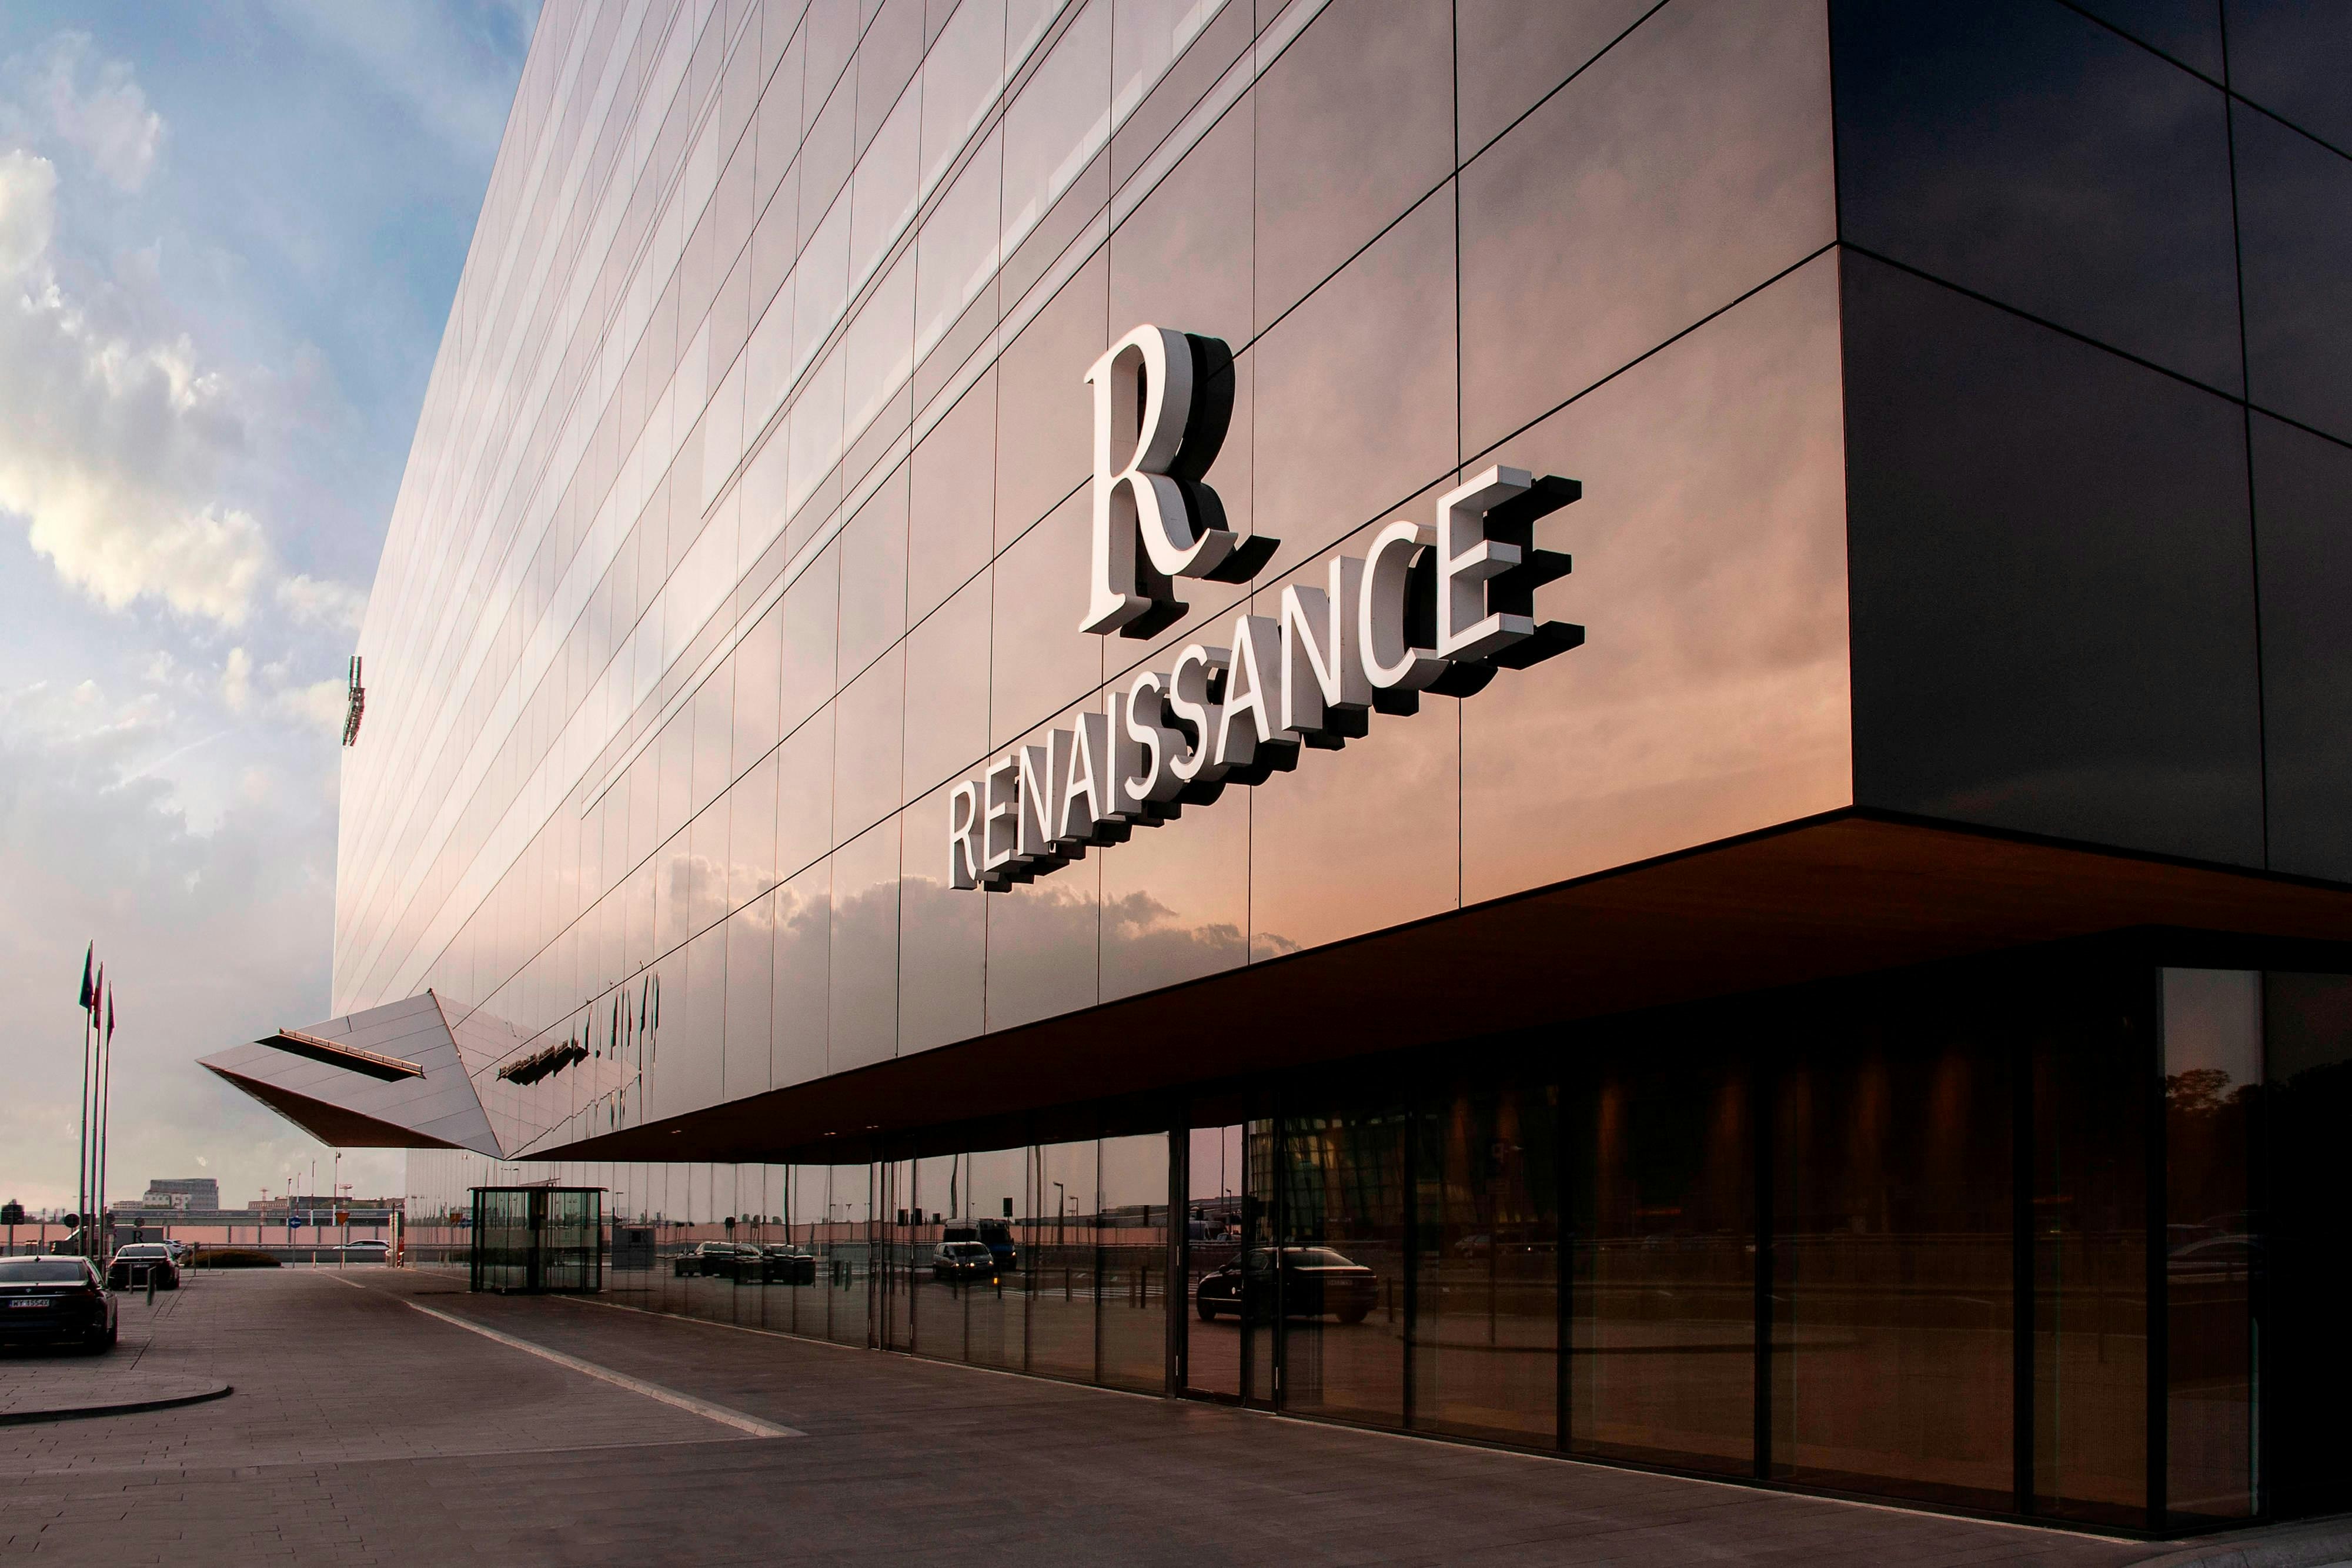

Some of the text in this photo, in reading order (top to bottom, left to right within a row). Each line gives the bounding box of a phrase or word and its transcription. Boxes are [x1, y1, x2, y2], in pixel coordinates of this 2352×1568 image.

[1078, 324, 1238, 634] R
[949, 464, 1534, 890] RENAISSANCE
[132, 1230, 145, 1243] R
